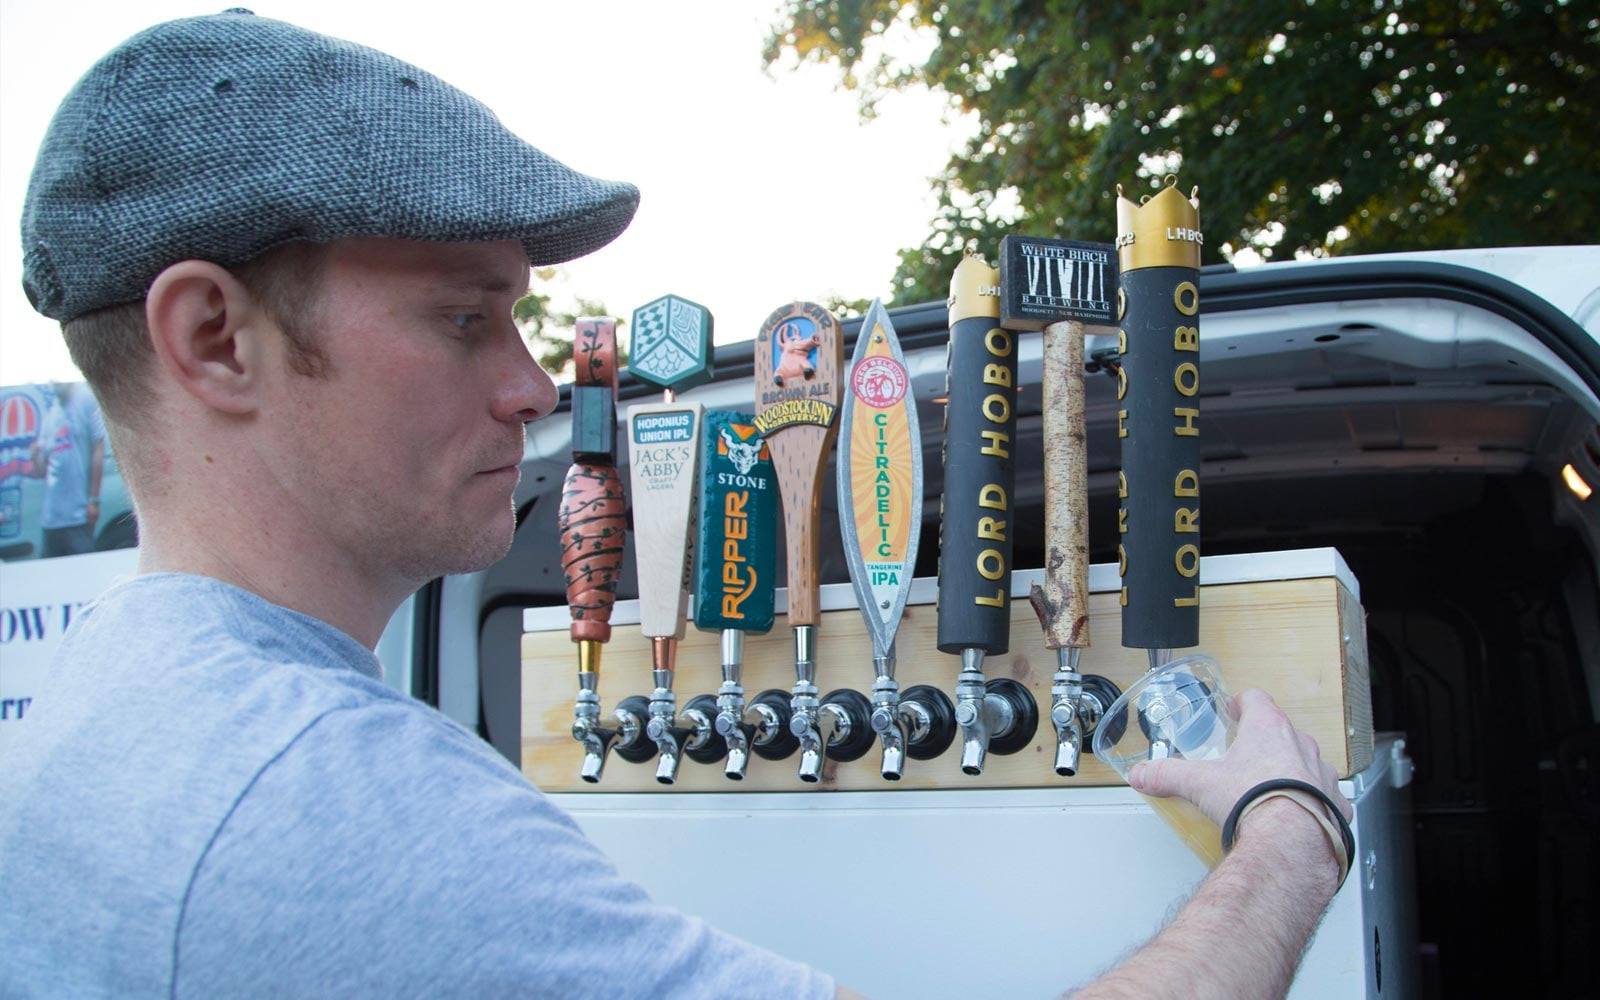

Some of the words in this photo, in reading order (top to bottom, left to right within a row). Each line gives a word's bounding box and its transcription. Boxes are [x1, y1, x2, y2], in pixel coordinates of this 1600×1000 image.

[1021, 243, 1065, 259] WHITE
[1068, 248, 1108, 263] BIRCH
[1022, 294, 1110, 311] BREWING
[1174, 280, 1200, 437] HOBO
[762, 386, 806, 405] BROWN
[810, 382, 830, 397] ALE
[981, 327, 1013, 459] HOBO
[637, 415, 689, 429] HOPONIUS
[754, 400, 812, 434] WOODSTOCK
[811, 399, 833, 426] INN
[639, 429, 672, 443] UNION
[673, 427, 690, 440] IPL
[634, 446, 690, 466] JACK'S
[640, 462, 684, 481] ABBY
[717, 472, 767, 490] STONE
[874, 413, 891, 557] CITRADELIC
[975, 483, 1008, 608] LORD
[1174, 469, 1200, 608] LORD
[721, 490, 757, 620] RIPPER
[872, 572, 899, 586] IPA
